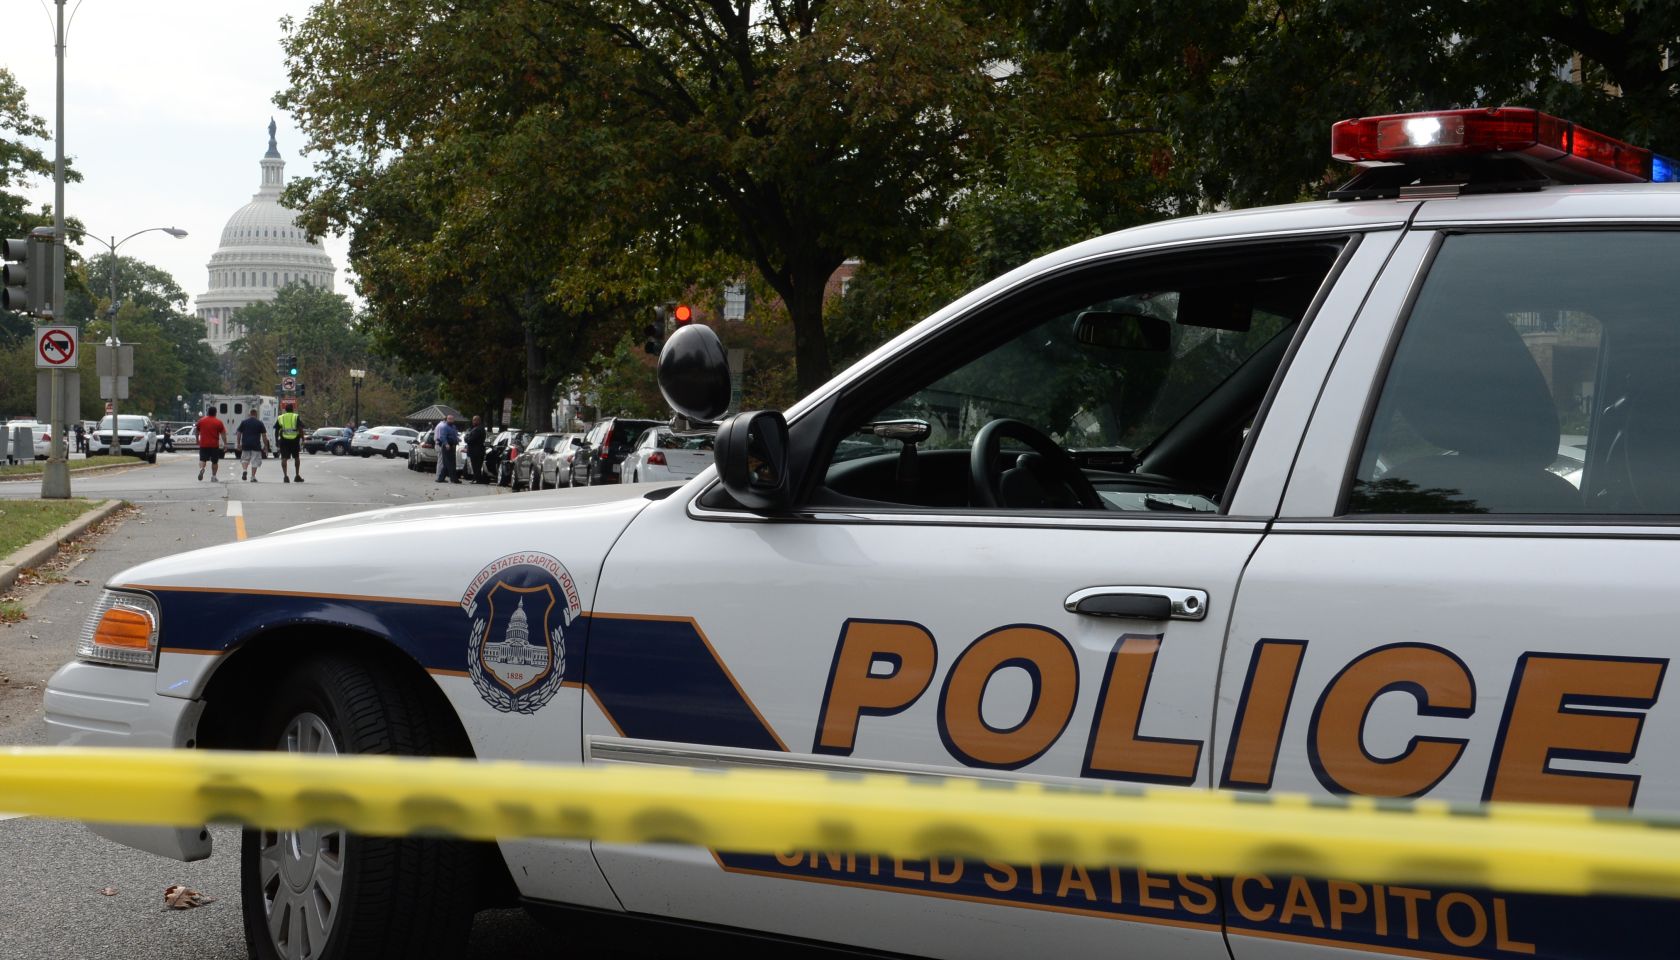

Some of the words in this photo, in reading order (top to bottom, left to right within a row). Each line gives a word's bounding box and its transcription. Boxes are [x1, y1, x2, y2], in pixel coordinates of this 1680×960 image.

[463, 570, 490, 606] UNITED
[490, 554, 525, 575] STATES
[526, 554, 561, 576] CAPITOL
[559, 572, 580, 611] POLICE
[812, 617, 1670, 811] POLICE
[1231, 872, 1536, 954] CAPITOL
